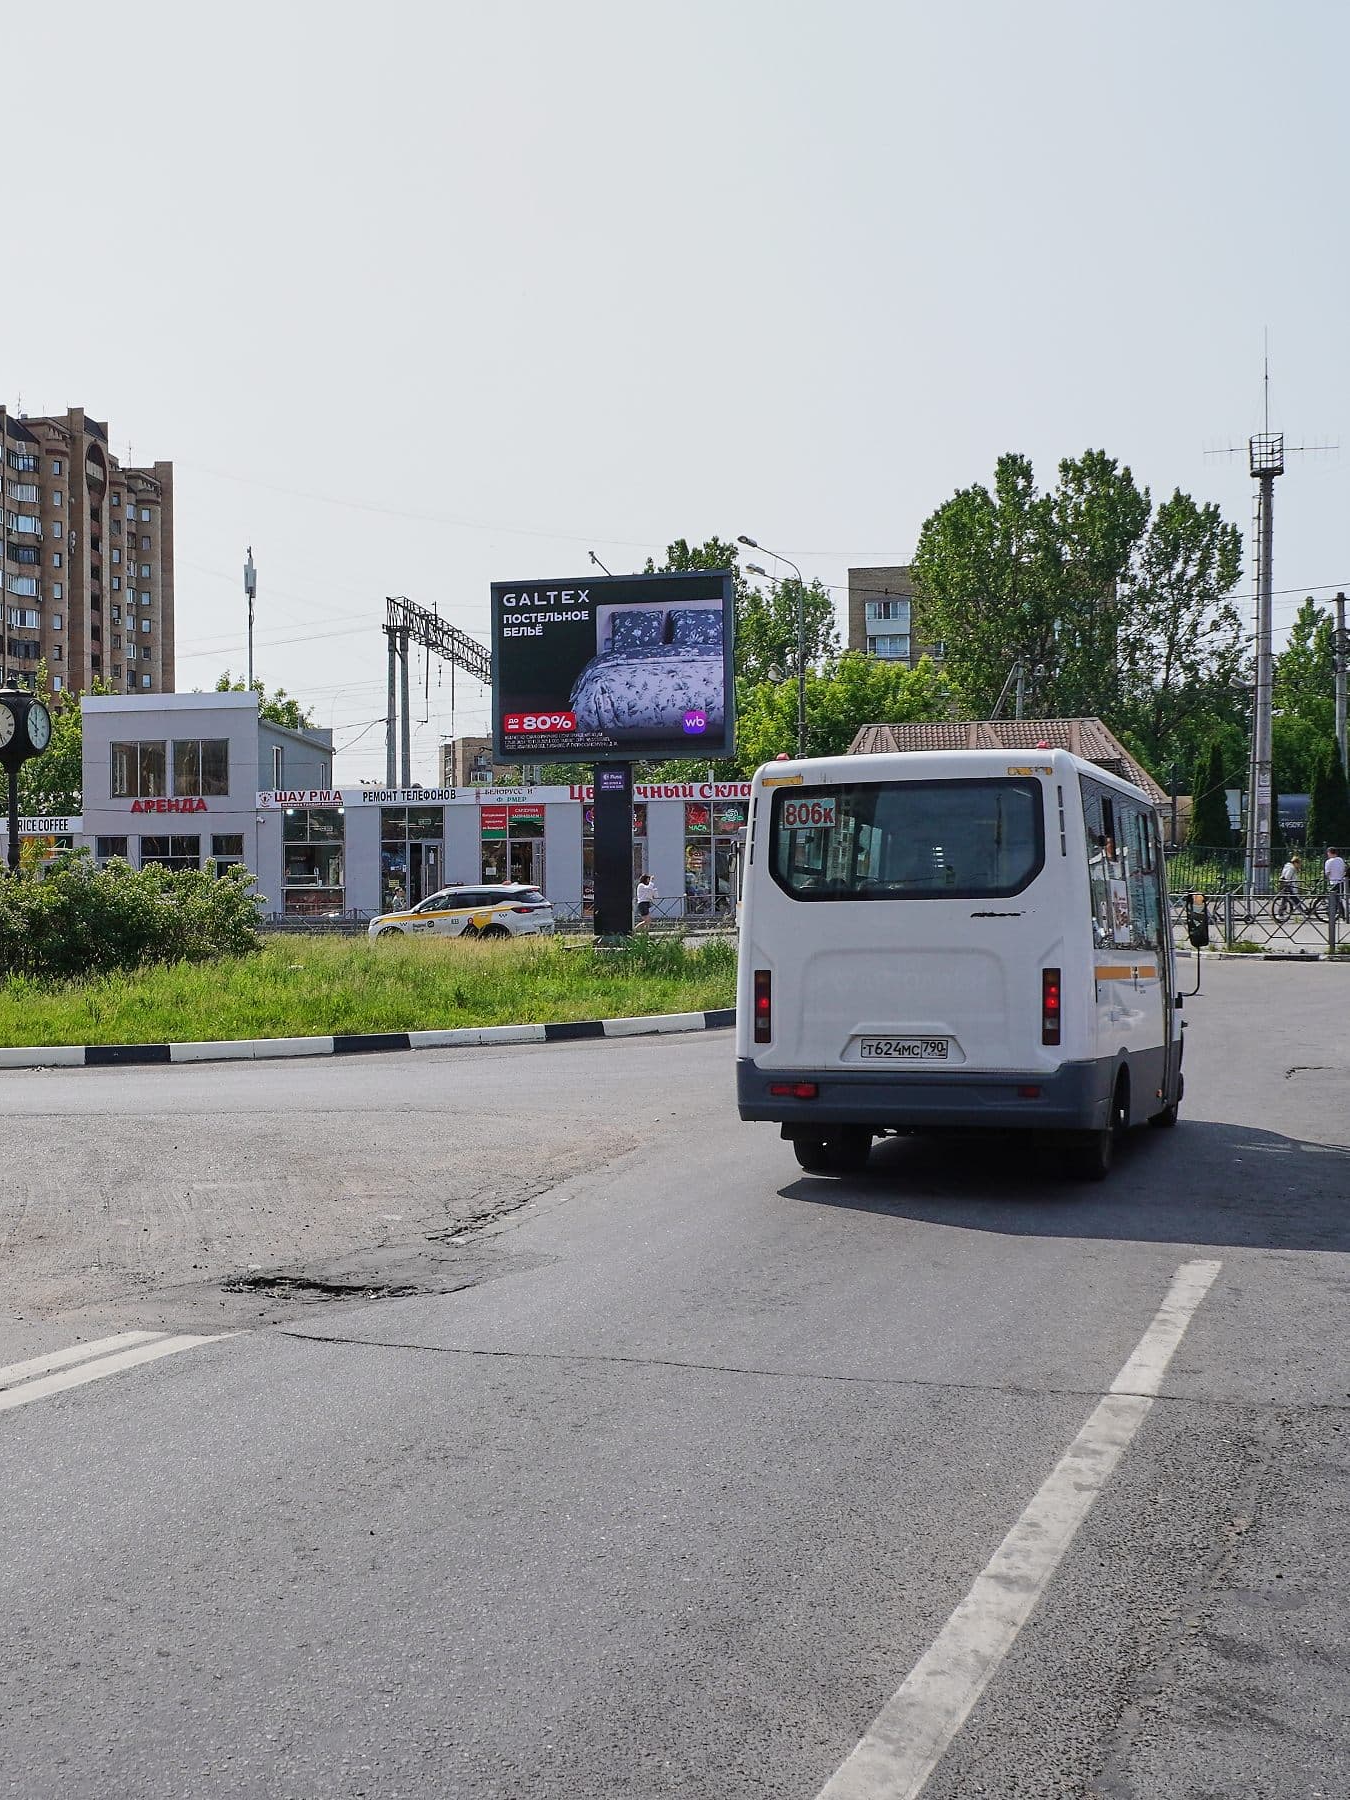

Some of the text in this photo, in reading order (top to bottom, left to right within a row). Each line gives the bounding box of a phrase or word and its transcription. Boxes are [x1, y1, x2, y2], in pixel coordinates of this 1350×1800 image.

[503, 590, 590, 607] GALTEX
[503, 610, 590, 625] ПОСТЕЛЬНОЕ
[503, 624, 544, 638] БЕЛЬЁ
[685, 716, 705, 728] wb
[362, 789, 456, 802] РЕМОНТ ТЕЛЕФОНОВ
[699, 783, 753, 799] Скла
[130, 797, 208, 813] АРЕНДА
[17, 819, 37, 832] RICE
[38, 818, 69, 831] COFFEE
[922, 1041, 944, 1053] 790
